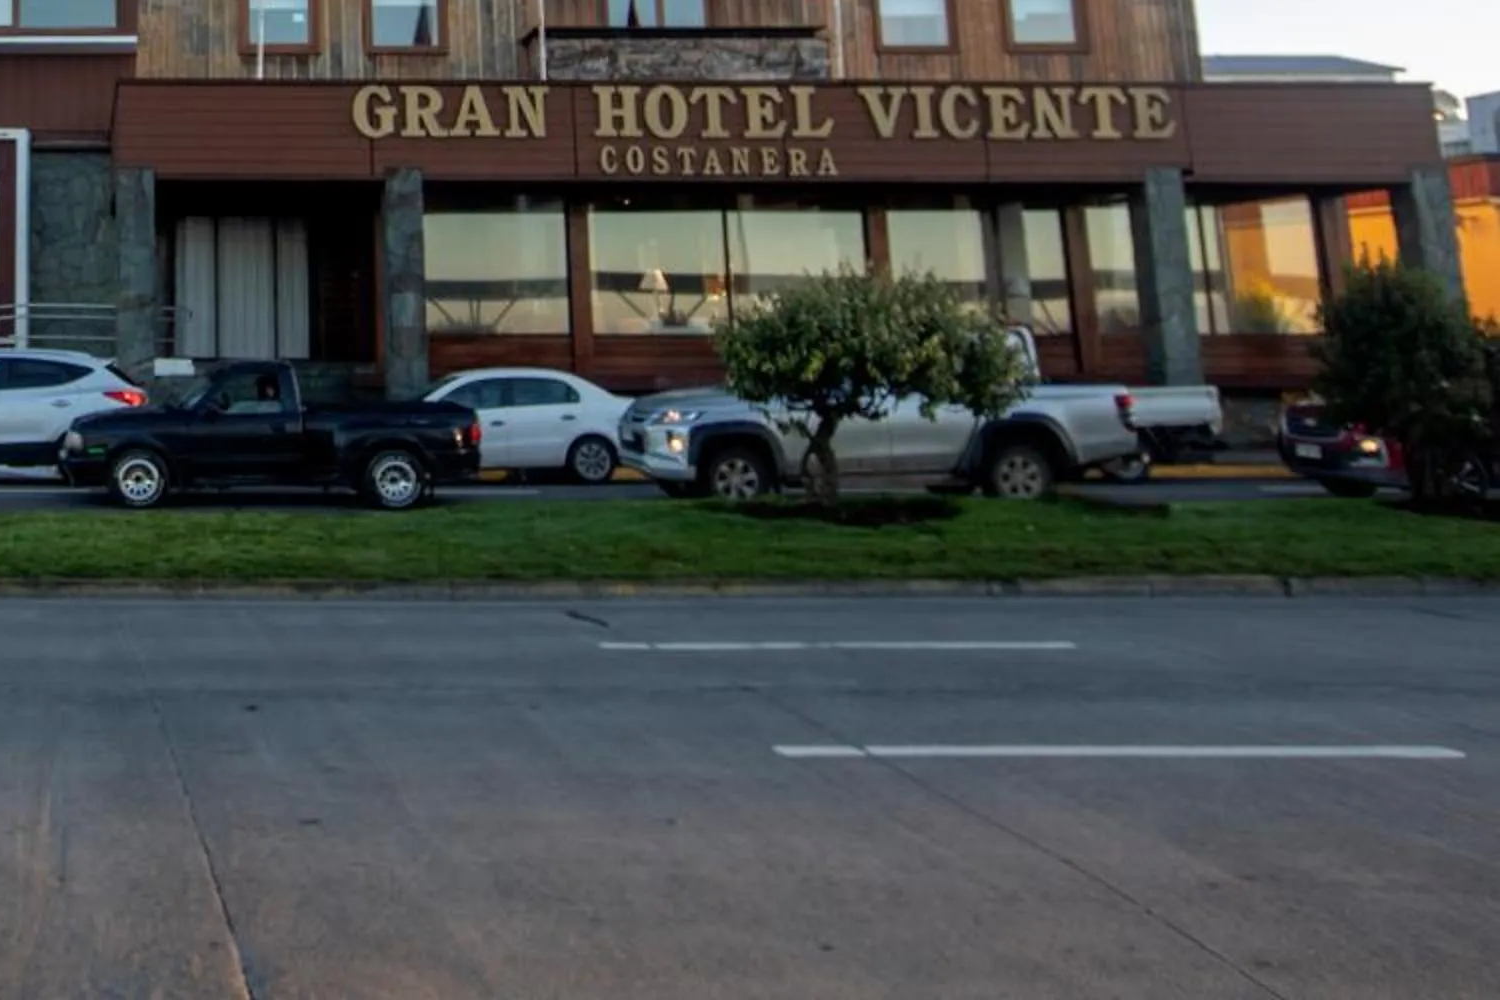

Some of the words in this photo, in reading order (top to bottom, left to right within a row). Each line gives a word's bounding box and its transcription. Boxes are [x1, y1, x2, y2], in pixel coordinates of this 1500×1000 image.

[351, 85, 548, 138] GRAN
[594, 85, 834, 140] HOTEL
[858, 87, 1176, 140] VICENTE
[601, 146, 838, 175] COSTANERA
